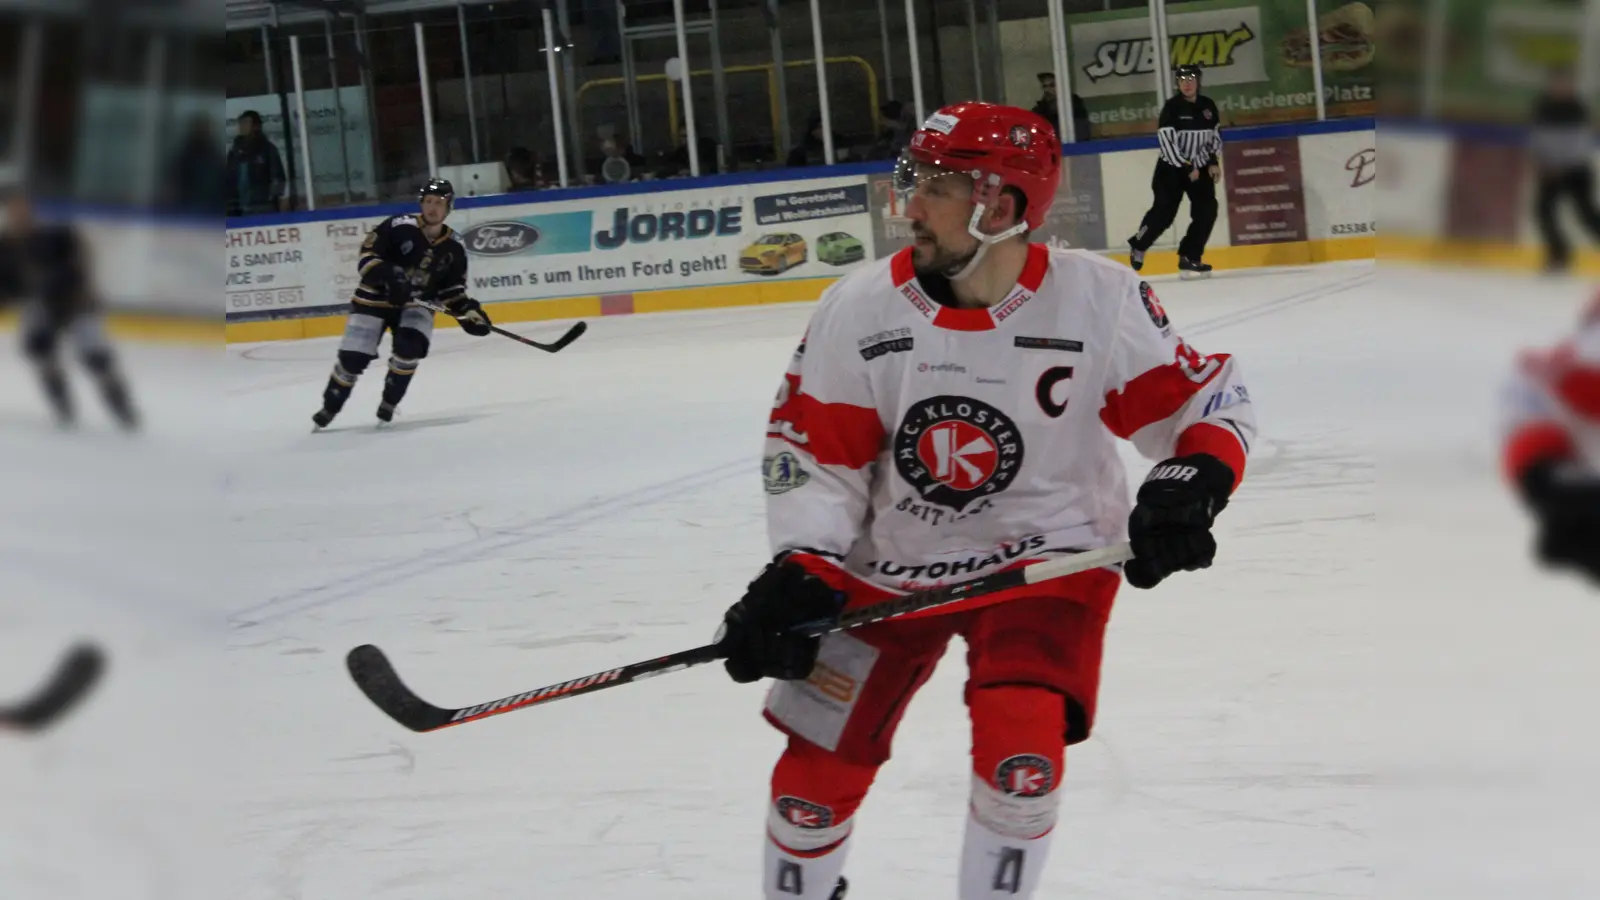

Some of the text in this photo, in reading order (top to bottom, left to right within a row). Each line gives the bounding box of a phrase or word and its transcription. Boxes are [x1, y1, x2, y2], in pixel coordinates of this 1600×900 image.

[1089, 103, 1159, 123] eretsrie
[473, 226, 524, 250] Ford
[594, 206, 742, 250] JORDE
[545, 267, 572, 283] um
[578, 264, 626, 282] Ihren
[632, 258, 674, 276] Ford
[680, 254, 728, 276] geht!
[900, 286, 931, 318] RIEDL
[995, 295, 1032, 322] RIEDL
[1035, 366, 1074, 418] C
[896, 496, 945, 527] SEIT
